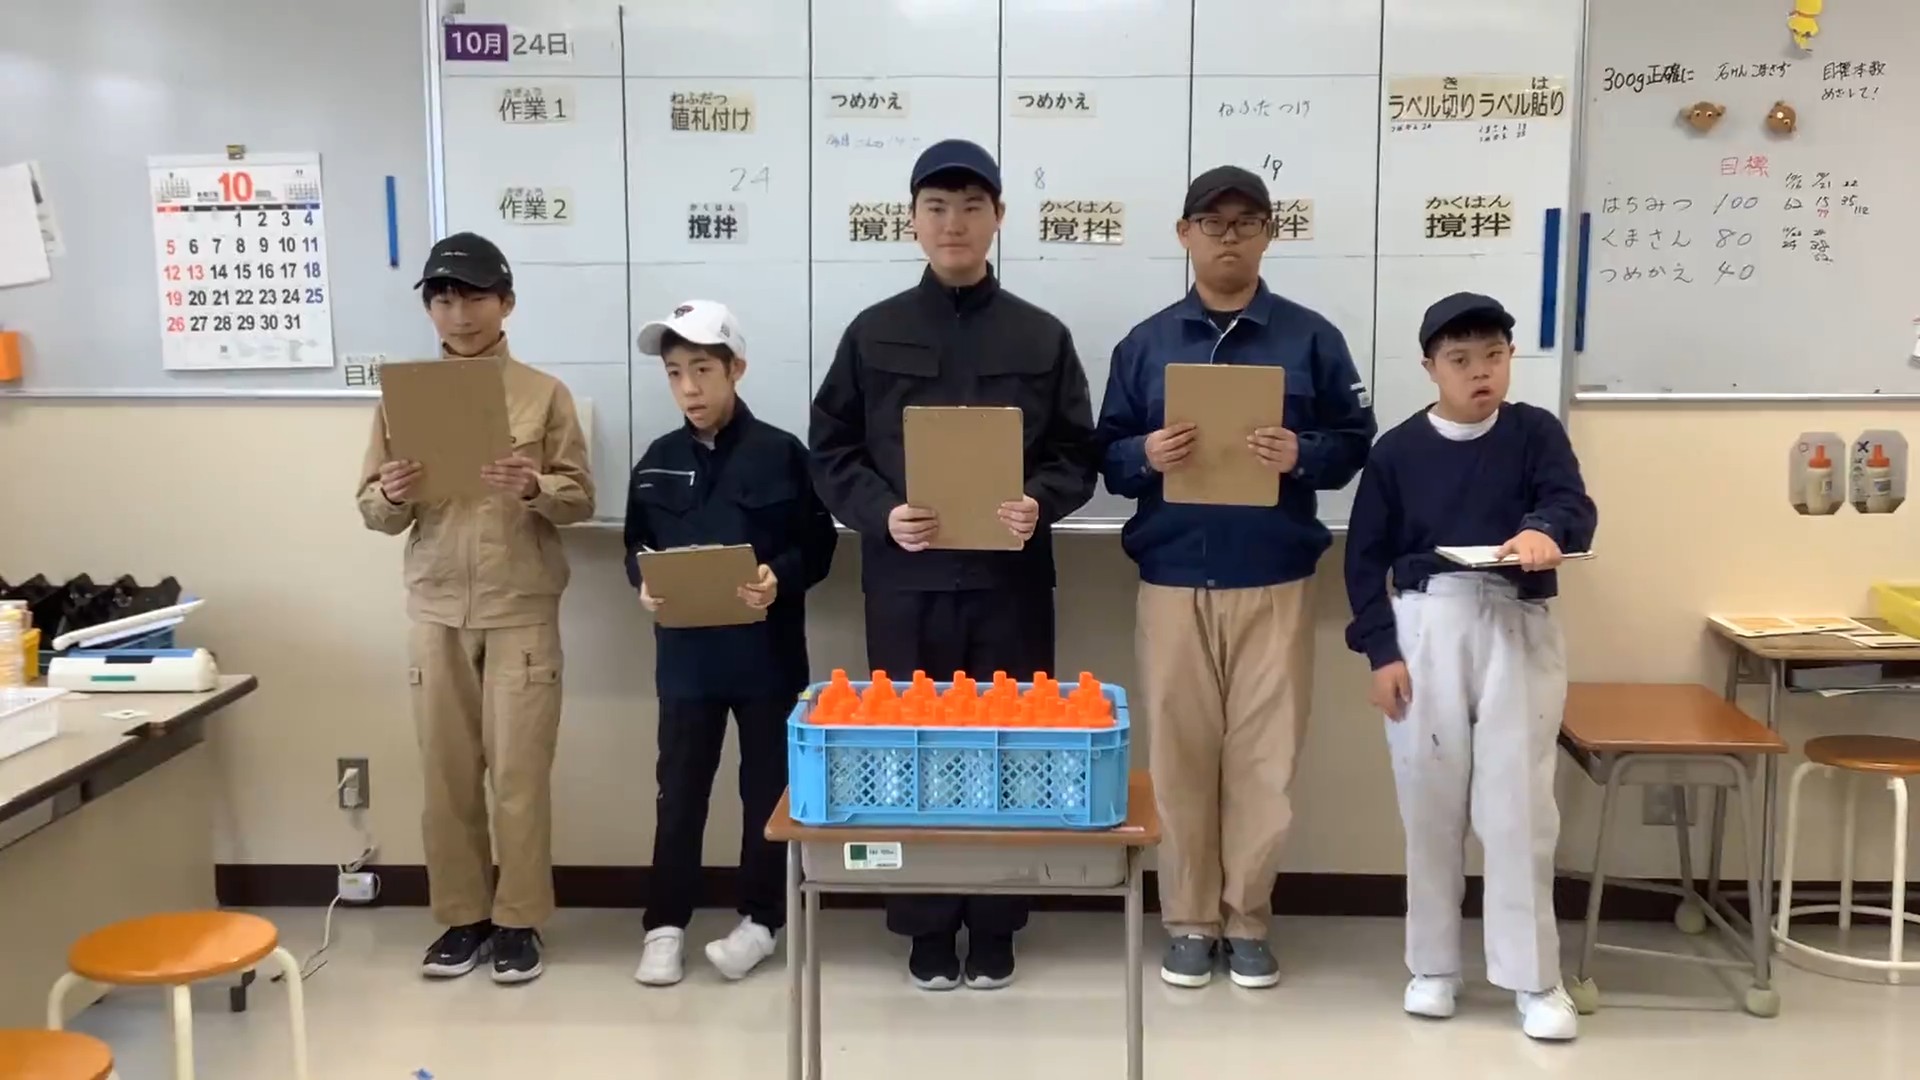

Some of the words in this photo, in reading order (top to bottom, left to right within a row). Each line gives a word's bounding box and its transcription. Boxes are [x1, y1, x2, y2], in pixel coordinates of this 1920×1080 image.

[451, 31, 501, 55] 10月
[512, 33, 567, 55] 24日
[1442, 76, 1458, 90] き
[1531, 76, 1549, 90] は
[1603, 62, 1694, 93] 300g正確に
[671, 91, 728, 105] ねふだつ
[831, 92, 902, 110] つめかえ
[1018, 93, 1089, 110] つめかえ
[1389, 93, 1475, 120] ラベル切り
[1479, 91, 1564, 117] ラベル貼り
[671, 106, 751, 131] 値札付け
[1721, 156, 1770, 178] 目標
[218, 172, 254, 202] 10
[729, 166, 769, 192] 24
[1034, 167, 1046, 190] 8
[498, 196, 568, 220] 作業2
[849, 202, 913, 216] かくは
[1040, 200, 1122, 214] かくはん
[1425, 195, 1511, 210] かくはん
[1602, 195, 1694, 213] はちみつ
[1713, 193, 1759, 215] 100
[235, 211, 243, 227] 1
[257, 211, 268, 227] 2
[281, 211, 291, 227] 3
[304, 211, 314, 226] 4
[1271, 214, 1309, 239] 拌
[166, 239, 176, 255] 5
[189, 238, 199, 254] 6
[212, 238, 222, 254] 7
[236, 237, 246, 254] 8
[259, 237, 269, 253] 9
[278, 236, 296, 252] 10
[302, 236, 319, 252] 11
[1601, 229, 1692, 248] くまさん
[1715, 228, 1753, 248] 80
[164, 265, 181, 281] 12
[187, 265, 204, 281] 13
[210, 264, 228, 280] 14
[234, 264, 251, 280] 15
[257, 263, 275, 279] 16
[280, 263, 297, 279] 17
[304, 262, 321, 278] 18
[1600, 262, 1693, 284] つめかえ
[1714, 261, 1756, 284] 40
[166, 291, 182, 306] 19
[188, 290, 207, 306] 20
[212, 290, 230, 305] 21
[235, 289, 254, 305] 22
[258, 289, 277, 305] 23
[282, 289, 301, 304] 24
[305, 288, 324, 304] 25
[166, 317, 185, 332] 26
[190, 316, 208, 332] 27
[213, 315, 232, 331] 28
[237, 315, 255, 331] 29
[260, 314, 279, 330] 30
[284, 314, 301, 329] 31
